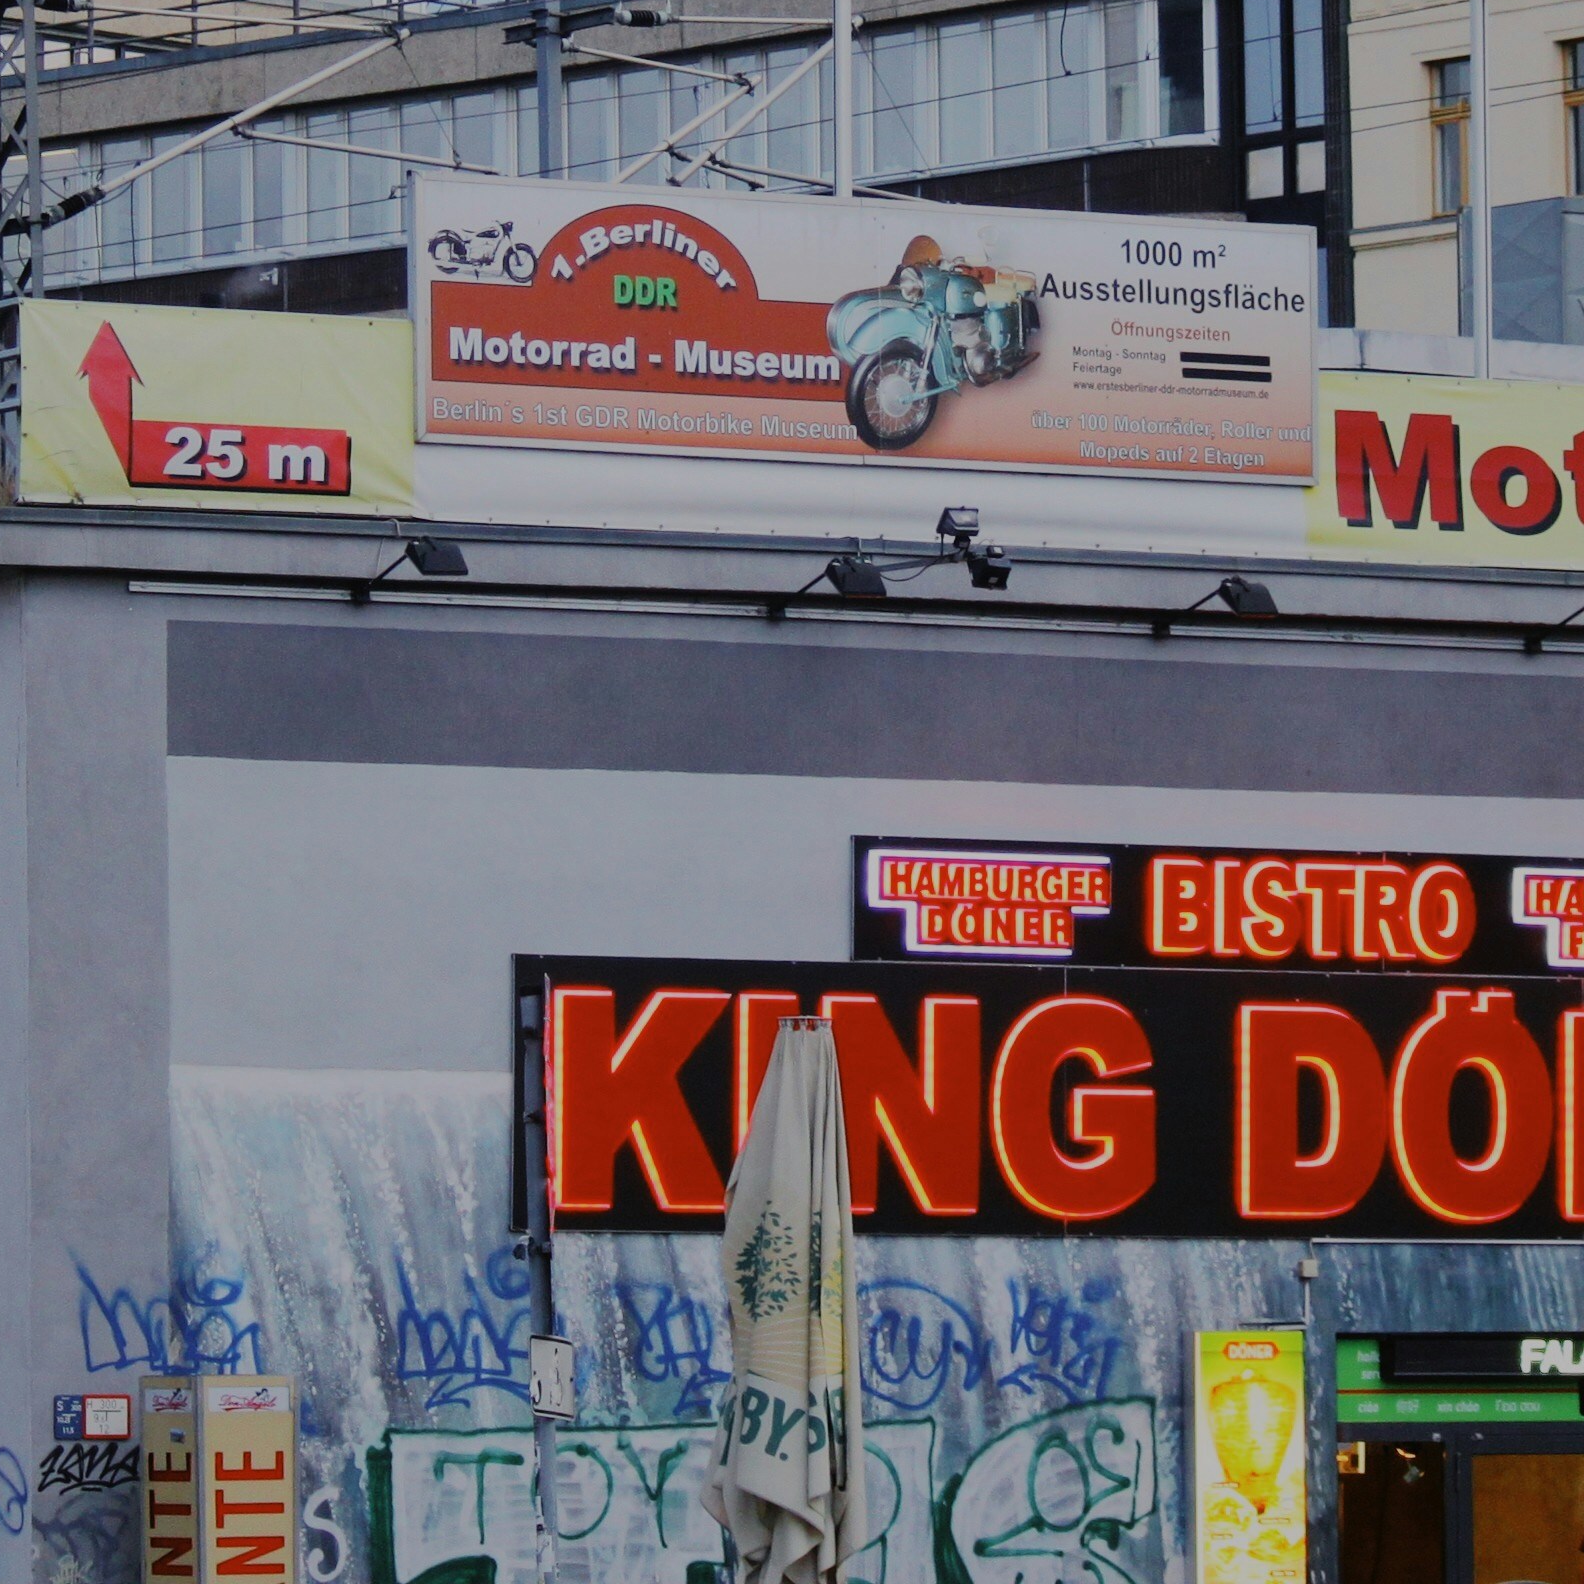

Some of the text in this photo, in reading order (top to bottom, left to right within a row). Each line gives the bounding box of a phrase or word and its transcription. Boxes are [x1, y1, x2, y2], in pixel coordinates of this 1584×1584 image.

[1120, 239, 1182, 266] 1000
[614, 274, 677, 308] DDR
[1039, 273, 1305, 314] Ausstellungsfläche
[1111, 317, 1230, 342] Öffnungszeiten
[449, 327, 635, 370] Motorrad
[674, 340, 841, 381] Museum
[1072, 347, 1112, 360] Montag
[1122, 348, 1166, 363] Sonntag
[1073, 362, 1122, 376] Feiertage
[533, 403, 567, 426] 1st
[576, 405, 629, 430] GDR
[637, 409, 752, 436] Motorbike
[760, 415, 858, 441] Museum
[1031, 410, 1312, 443] über 100 Motorräder, Roller und
[163, 426, 327, 482] 25 m
[1080, 441, 1264, 470] Mopeds auf 2 Etagen
[880, 860, 1110, 906] HAMBURGER
[922, 903, 1073, 947] DÖNER
[1148, 856, 1476, 963] BISTRO
